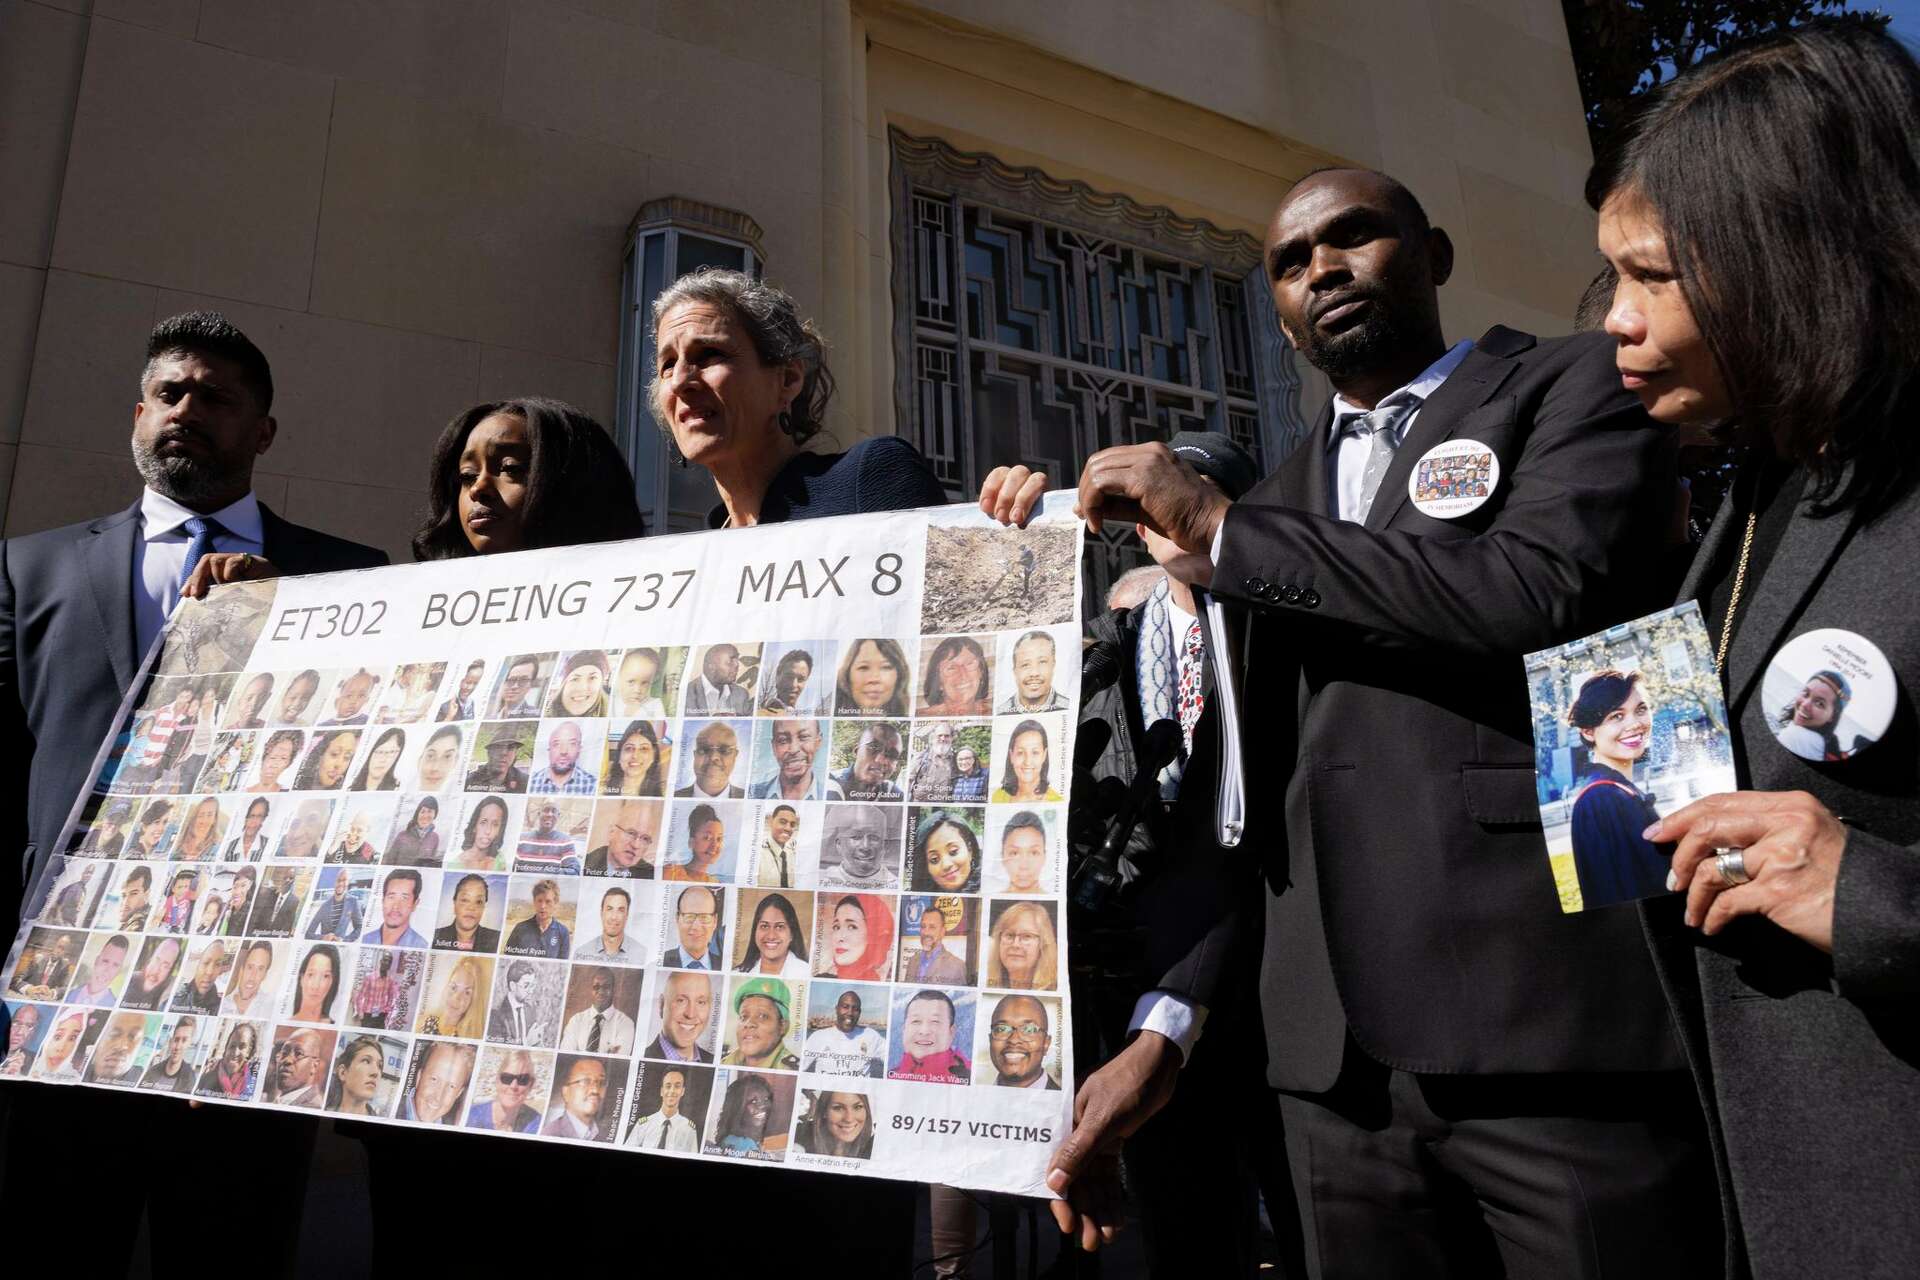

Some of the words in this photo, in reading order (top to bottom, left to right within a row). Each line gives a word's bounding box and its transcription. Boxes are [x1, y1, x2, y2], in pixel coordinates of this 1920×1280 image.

[271, 599, 388, 642] ET302
[421, 579, 593, 630] BOEING
[607, 568, 697, 613] 737
[736, 554, 852, 606] MAX
[870, 552, 904, 597] 8
[849, 790, 876, 799] George
[586, 868, 603, 876] Peter
[503, 945, 528, 956] Michael
[529, 947, 546, 958] Ryan
[403, 1063, 418, 1097] Jonathan
[632, 1061, 647, 1102] Getachew
[888, 1071, 927, 1082] Chunming
[928, 1073, 945, 1083] Jack
[946, 1075, 970, 1086] Wang
[607, 1119, 617, 1142] Isaac
[612, 1086, 625, 1118] Mwangi
[629, 1103, 639, 1127] Yared
[891, 1113, 962, 1136] 89/157
[967, 1120, 1053, 1144] VICTIMS
